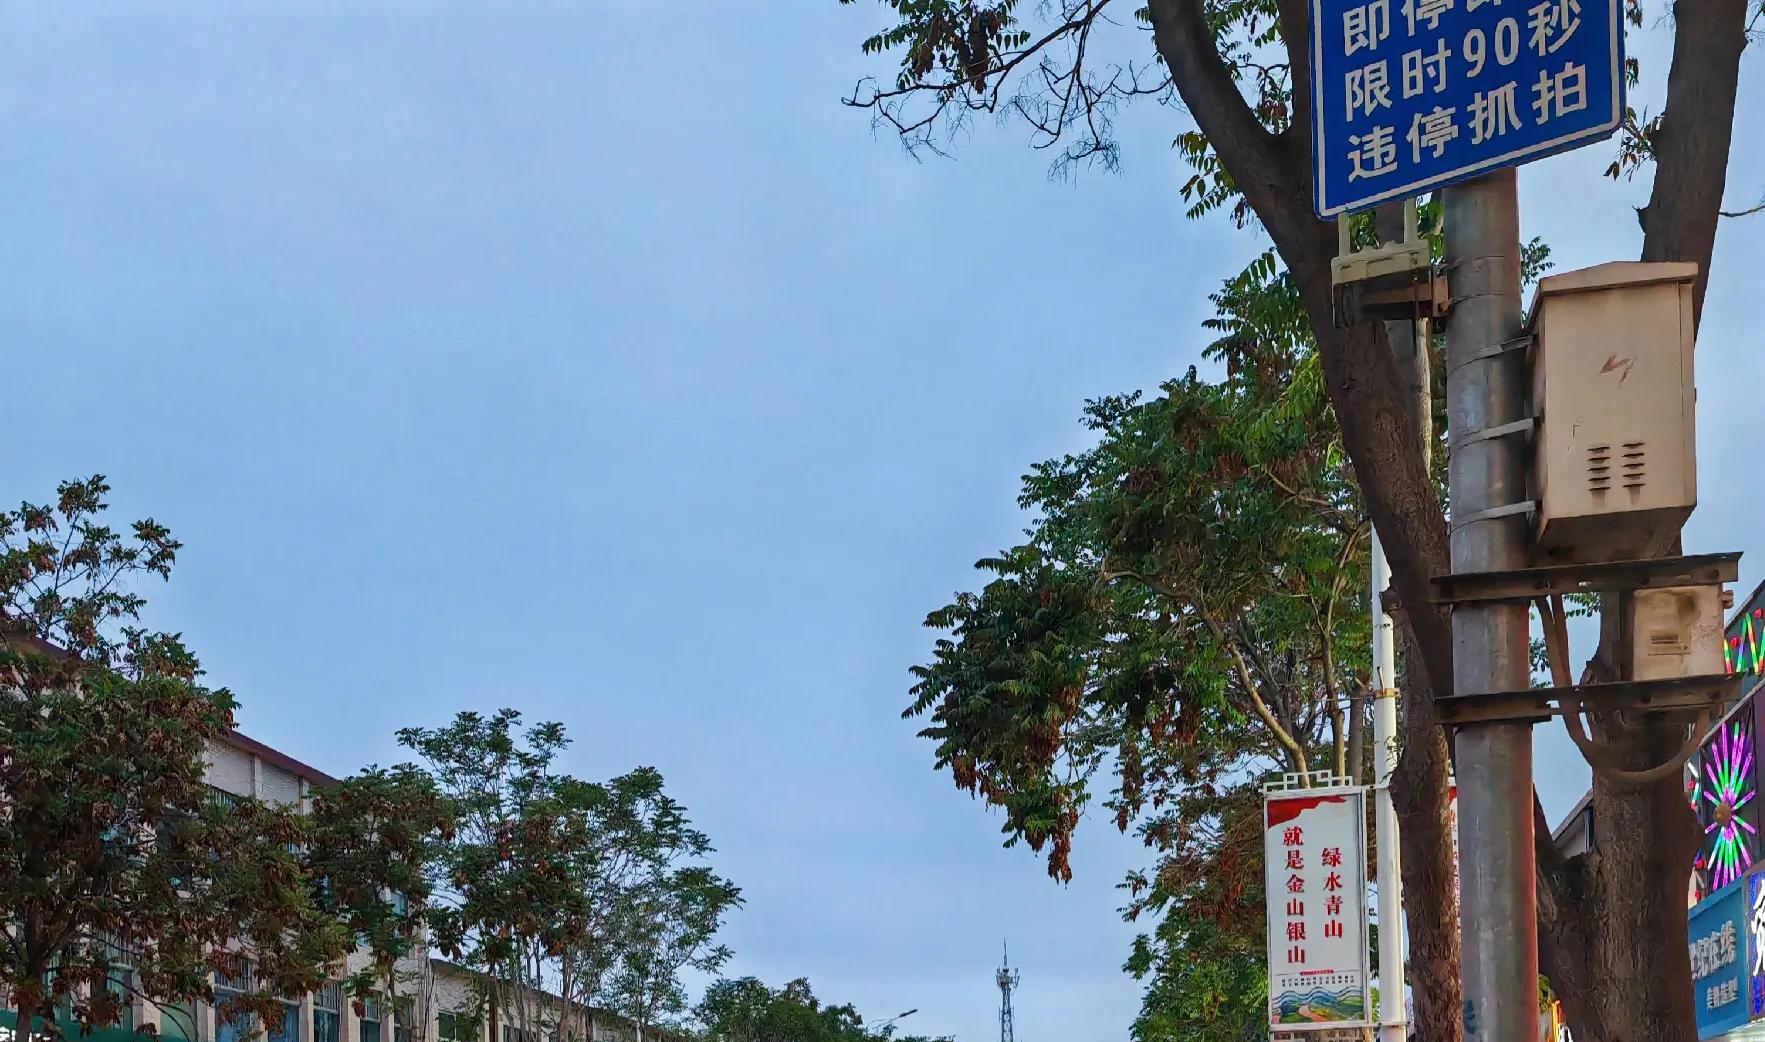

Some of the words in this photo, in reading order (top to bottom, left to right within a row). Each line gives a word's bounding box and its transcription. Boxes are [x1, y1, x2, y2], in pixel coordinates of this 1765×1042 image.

[1342, 0, 1502, 56] 即停
[1345, 0, 1582, 122] 限时90秒
[1347, 61, 1588, 182] 违停抓拍
[1282, 826, 1306, 964] 就是金山银山
[1321, 847, 1343, 940] 绿水青山
